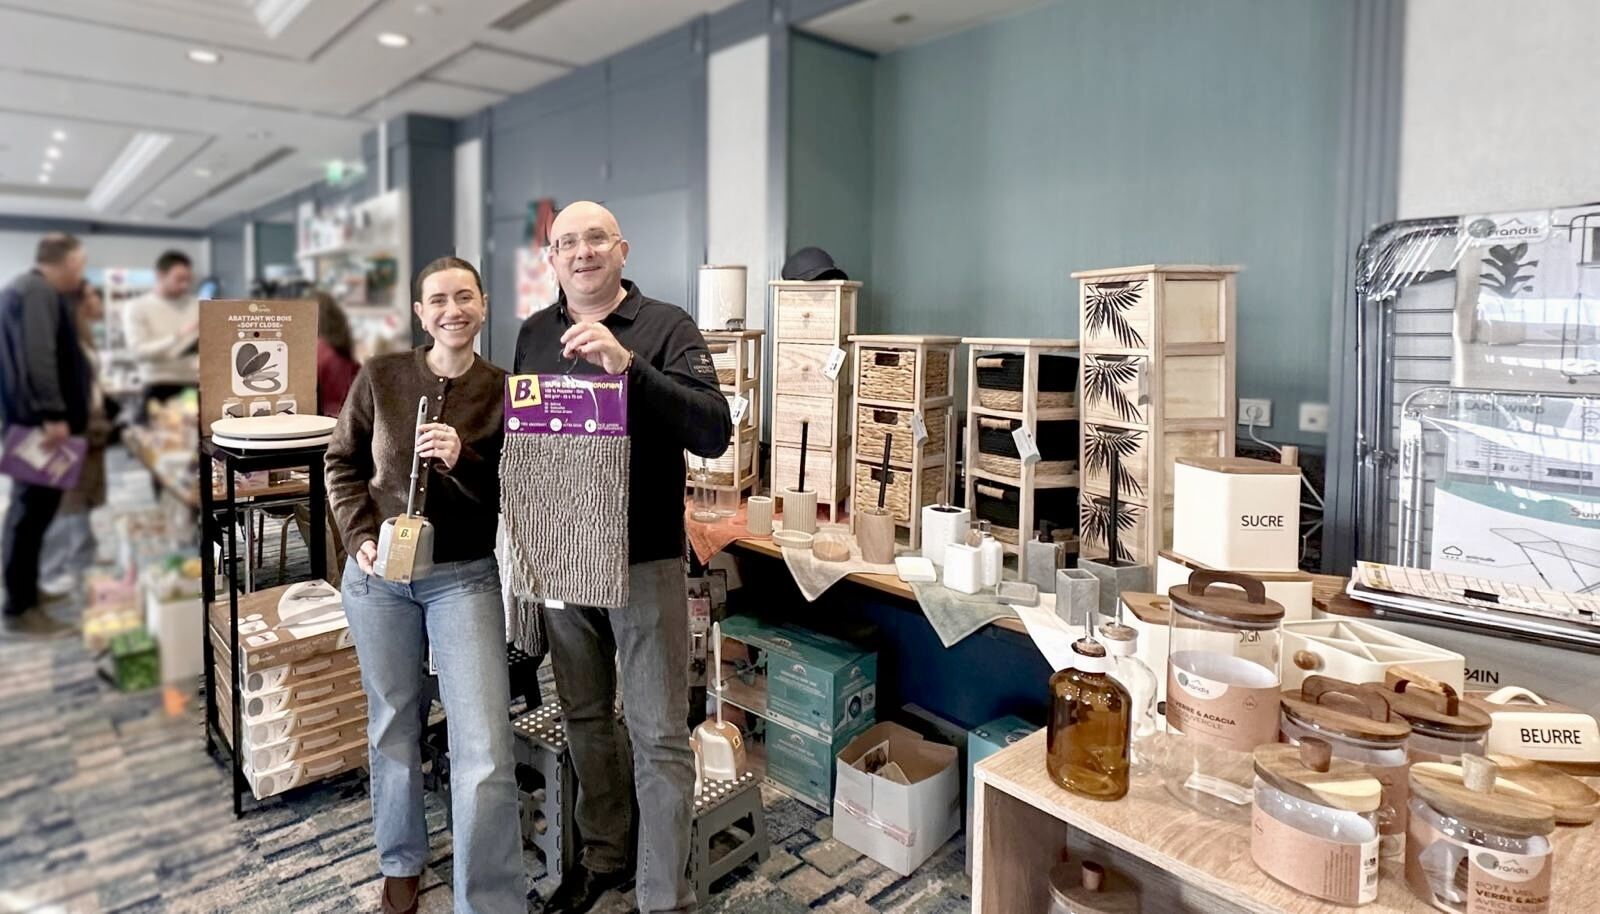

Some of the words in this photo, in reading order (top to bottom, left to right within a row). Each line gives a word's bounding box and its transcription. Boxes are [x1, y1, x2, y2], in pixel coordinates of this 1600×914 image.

[1488, 225, 1539, 236] Frandis
[1570, 506, 1600, 519] Sun
[1241, 515, 1285, 527] SUCRE
[1203, 713, 1237, 726] ACACIA
[1520, 728, 1582, 744] BEURRE
[1475, 888, 1513, 903] VERRE
